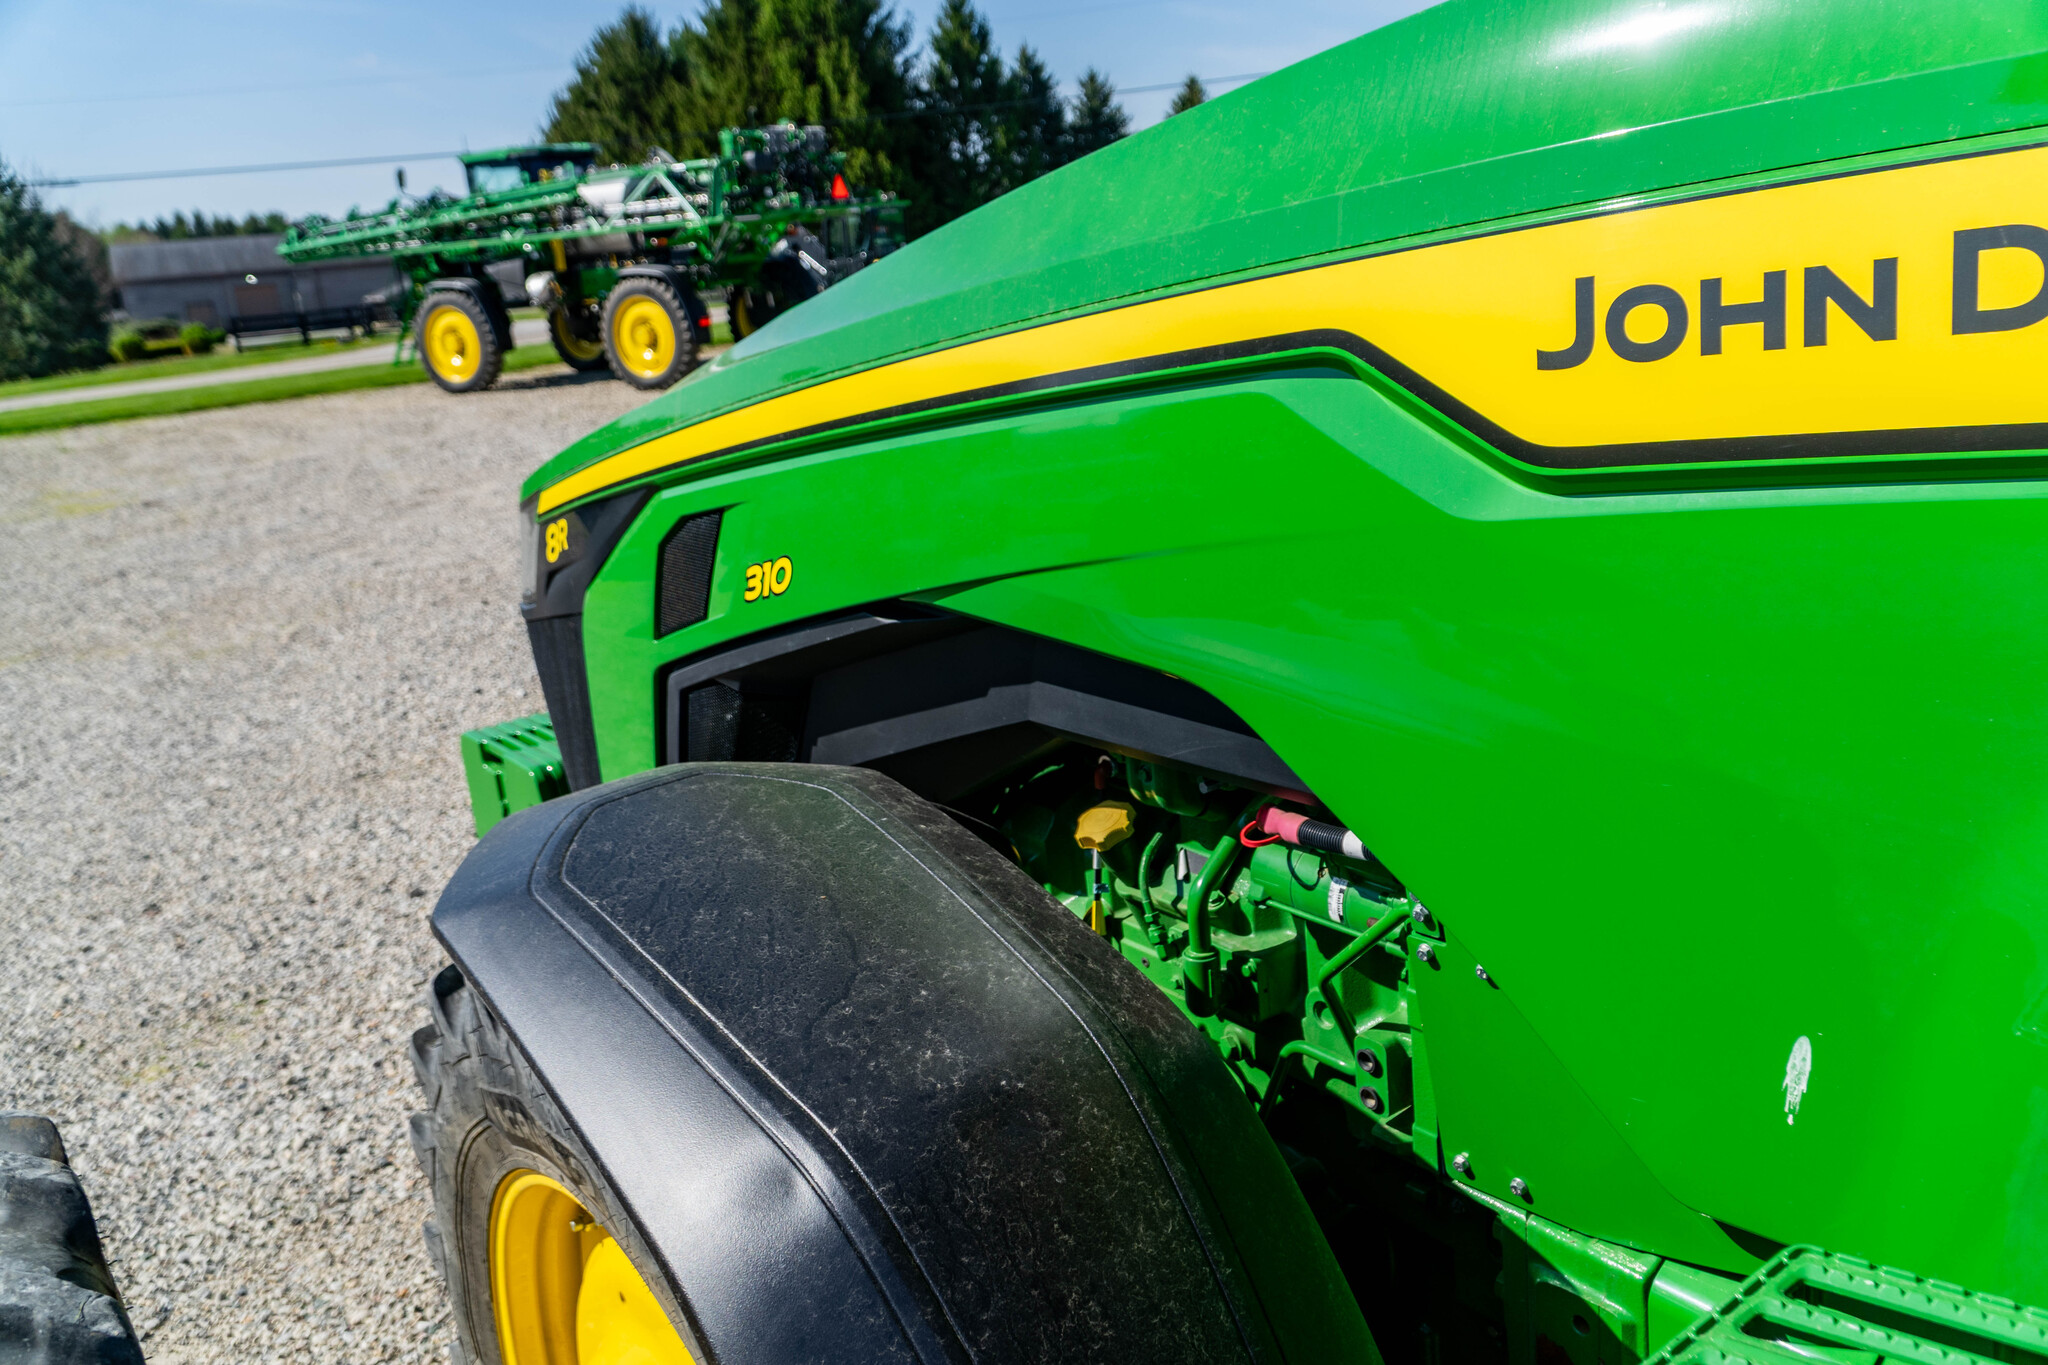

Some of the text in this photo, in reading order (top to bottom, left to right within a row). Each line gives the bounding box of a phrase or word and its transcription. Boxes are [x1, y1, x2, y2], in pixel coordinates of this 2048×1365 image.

[1536, 256, 1899, 371] JOHN
[545, 518, 569, 563] 8R
[743, 555, 793, 603] 310
